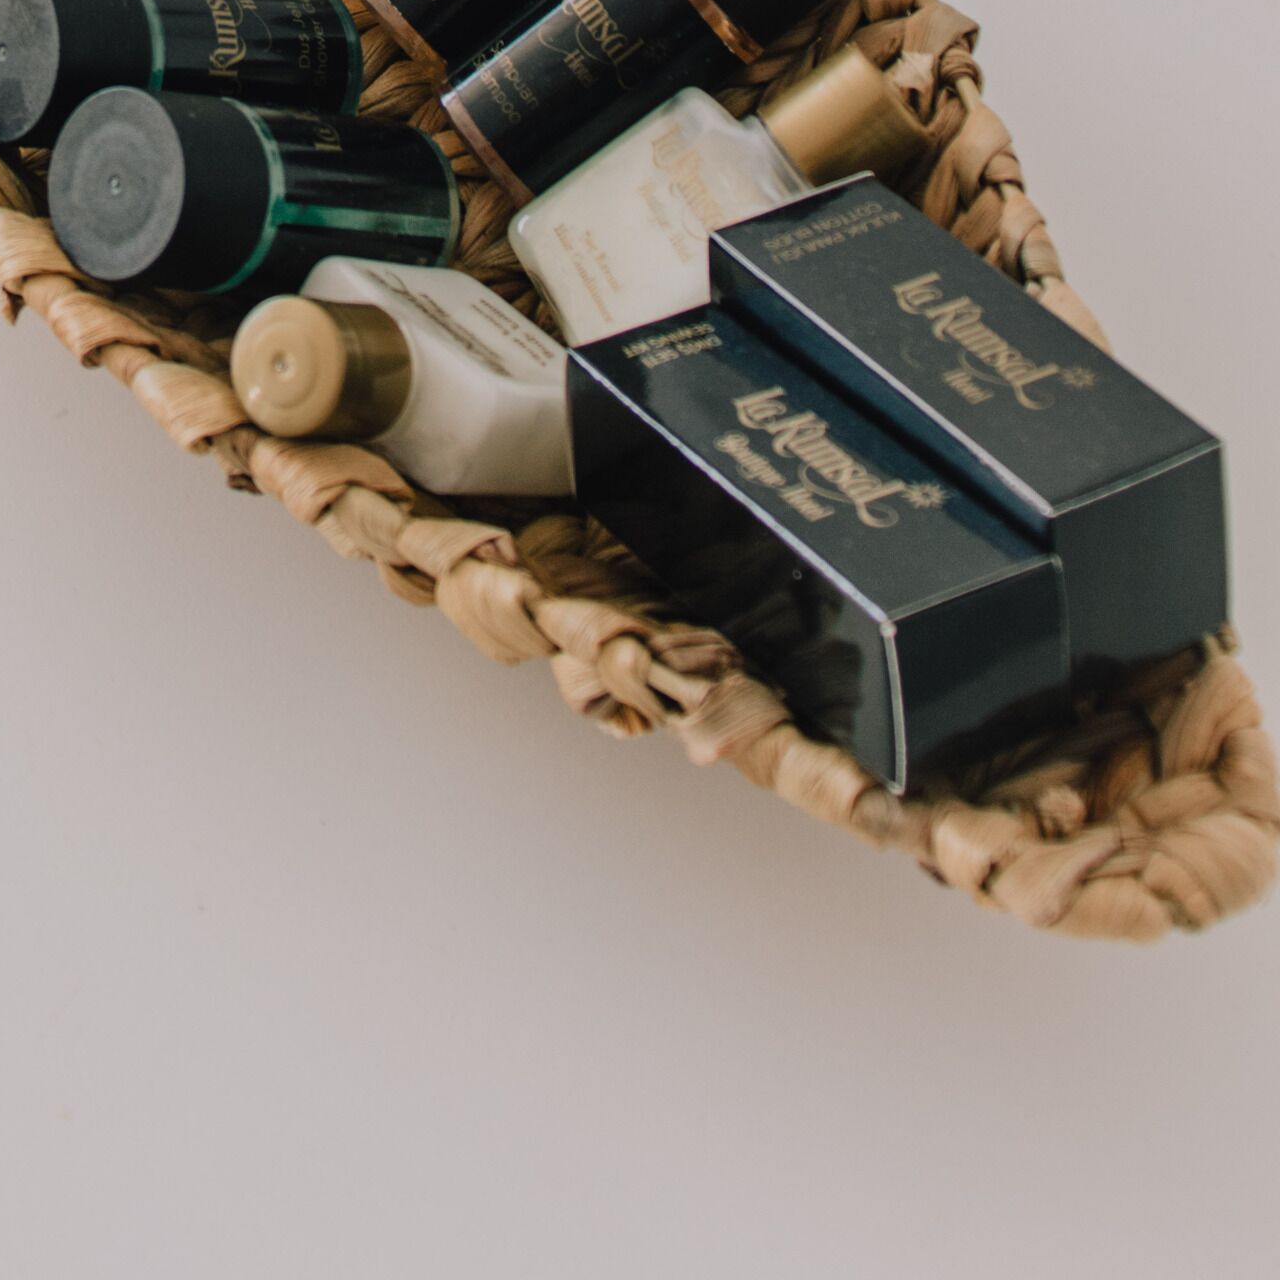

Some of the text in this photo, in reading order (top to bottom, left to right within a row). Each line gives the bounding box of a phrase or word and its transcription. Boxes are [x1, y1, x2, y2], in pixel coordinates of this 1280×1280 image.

[893, 271, 1062, 410] La Kumsal
[732, 385, 908, 528] La Kumsal
